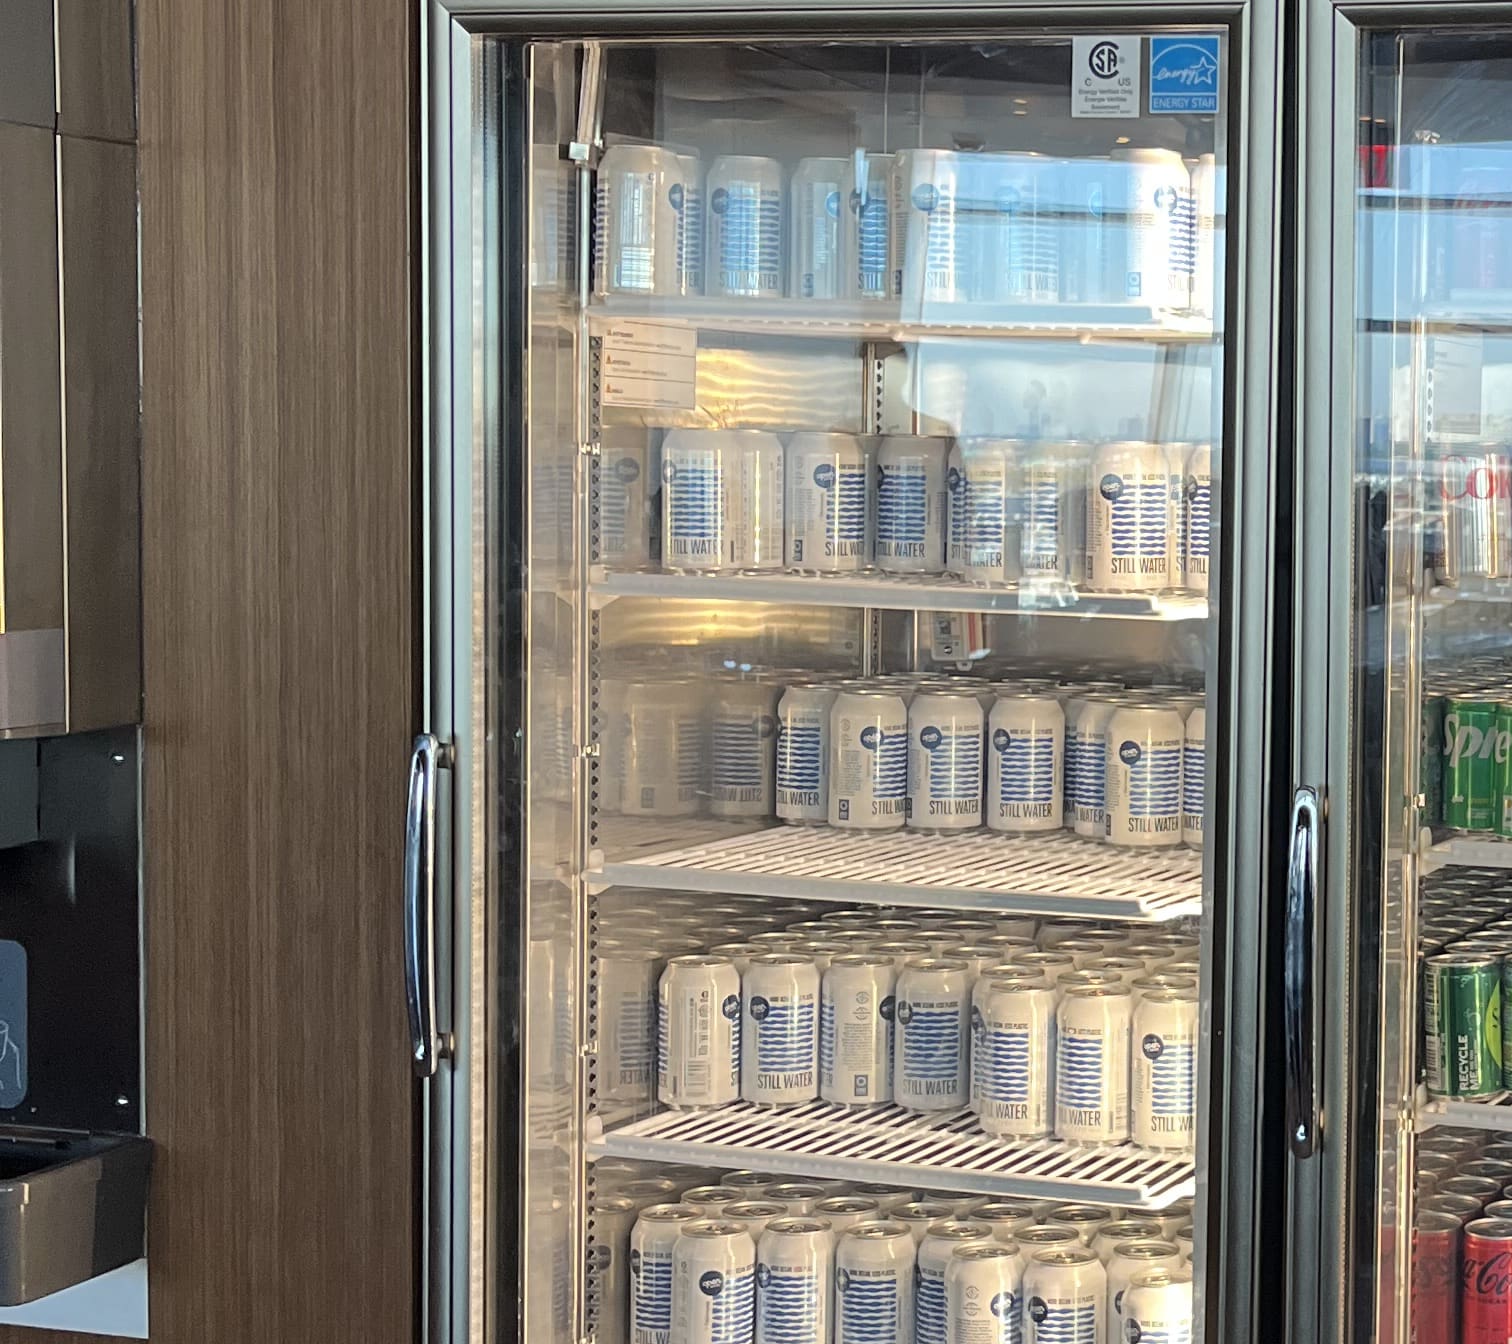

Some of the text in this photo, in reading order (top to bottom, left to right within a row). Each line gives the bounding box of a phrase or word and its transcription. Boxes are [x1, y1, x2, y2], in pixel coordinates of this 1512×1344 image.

[1154, 98, 1215, 108] ENERGY STAR
[1112, 557, 1166, 574] STILL WATER
[929, 800, 952, 815] STILL
[1000, 803, 1052, 818] STILL WATER
[1129, 818, 1152, 833] STILL
[1459, 1034, 1468, 1090] RECYCLE
[758, 1072, 813, 1090] STILL WATER
[903, 1079, 958, 1096] STILL WATER
[996, 1104, 1028, 1120] WATER
[1068, 1110, 1100, 1127] WATER
[1151, 1116, 1175, 1132] STILL
